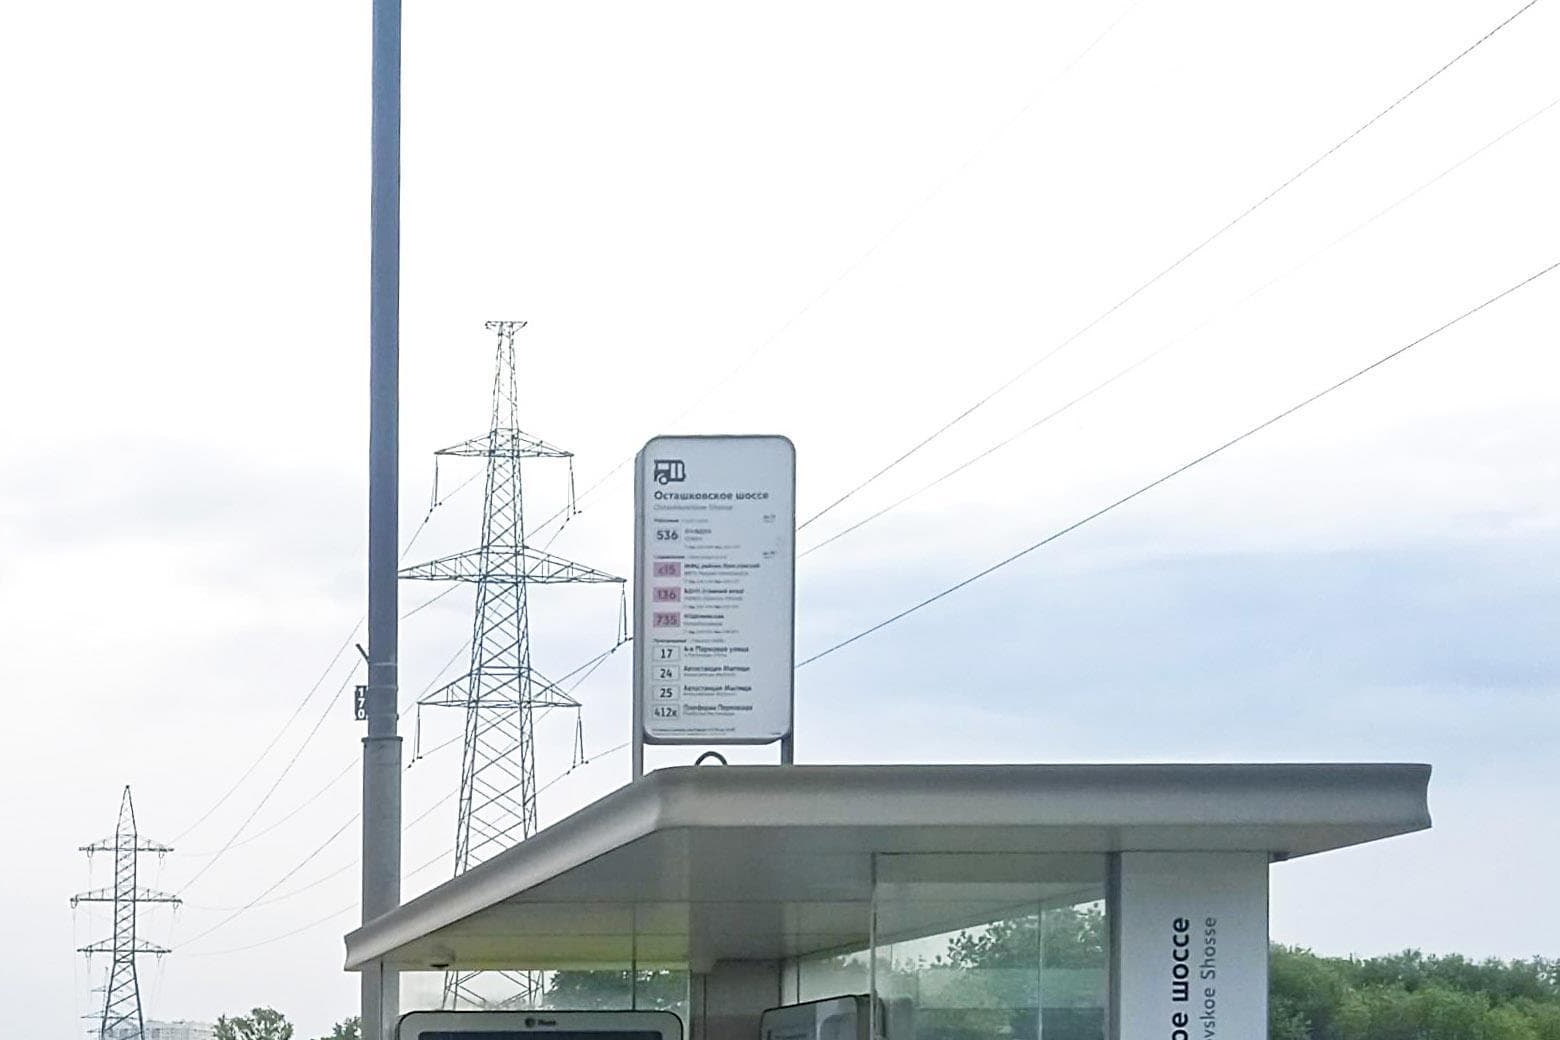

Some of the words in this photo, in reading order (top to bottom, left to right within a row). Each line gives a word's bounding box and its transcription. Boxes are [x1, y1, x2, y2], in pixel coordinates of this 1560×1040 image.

[654, 490, 733, 501] Осташковское
[735, 492, 769, 501] шоссе
[656, 530, 679, 540] 536
[661, 648, 673, 659] 17
[660, 668, 672, 678] 24
[660, 688, 673, 698] 25
[357, 687, 365, 719] 170
[1201, 917, 1217, 980] Shosse
[1172, 917, 1189, 1002] шоссе
